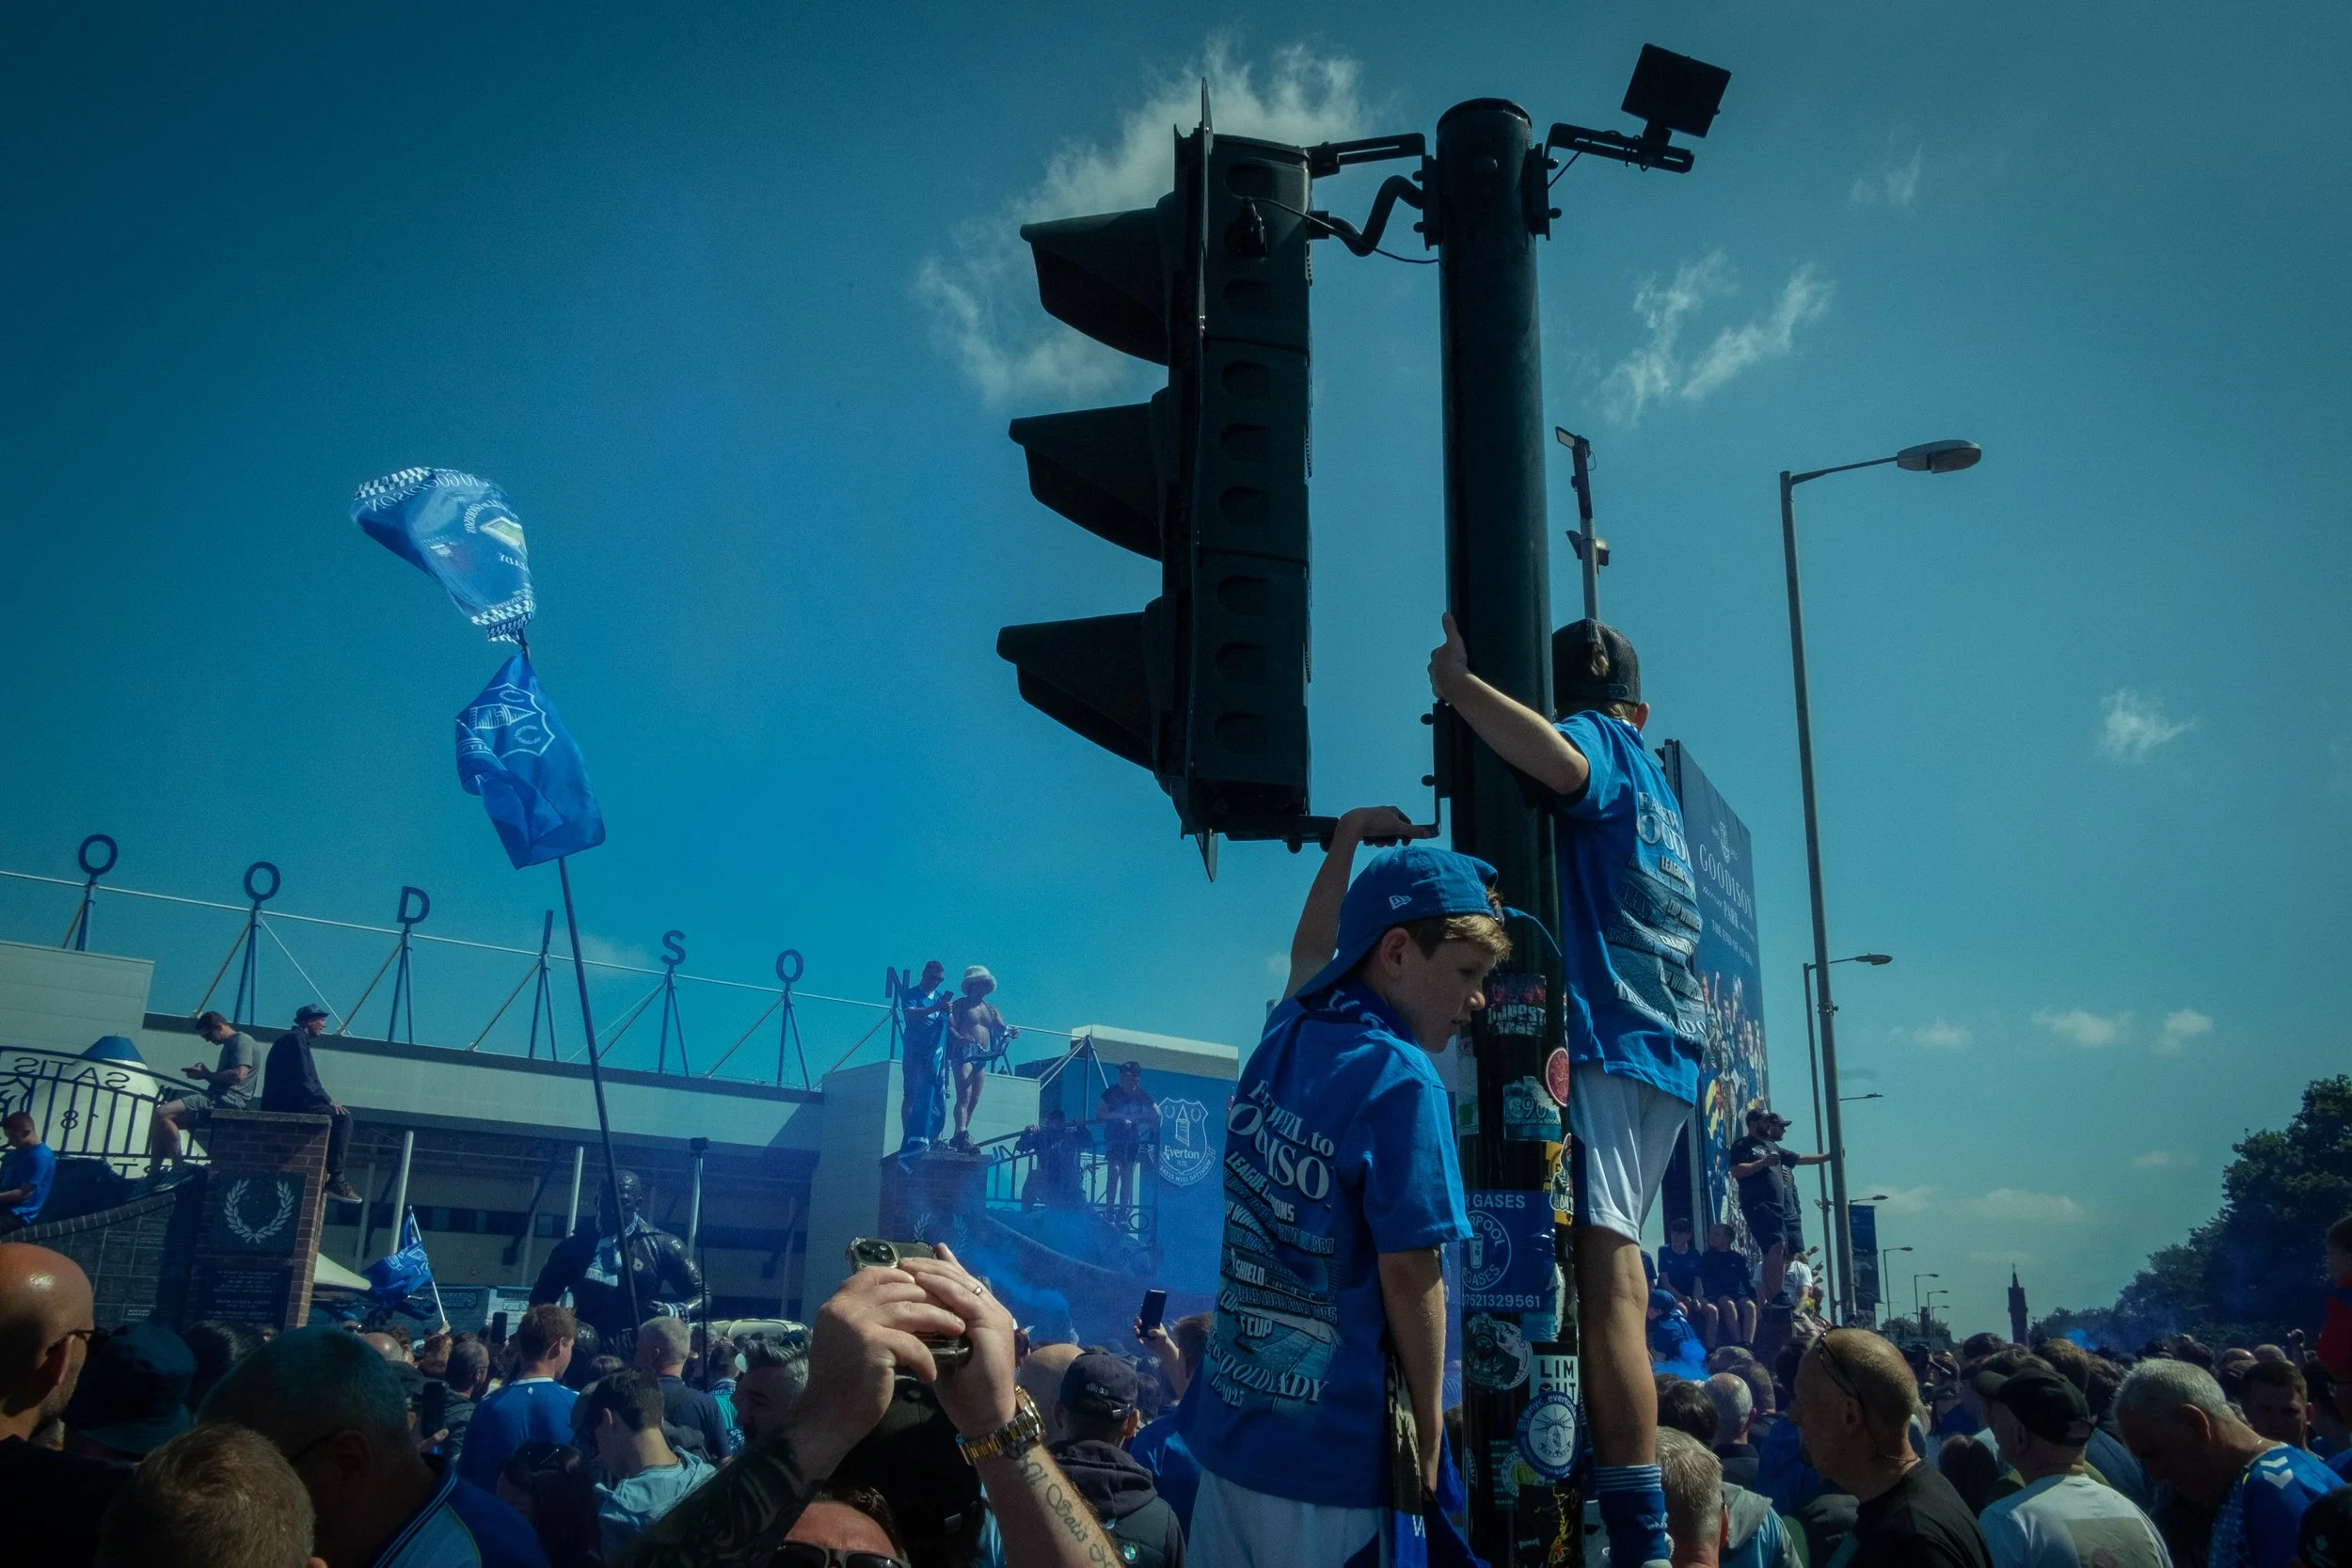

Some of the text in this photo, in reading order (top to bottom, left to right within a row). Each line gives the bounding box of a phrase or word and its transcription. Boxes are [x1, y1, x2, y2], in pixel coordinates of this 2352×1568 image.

[1699, 844, 1753, 922] GOODISON
[1164, 1145, 1200, 1160] Everton
[1311, 1131, 1335, 1157] to
[1225, 1150, 1268, 1194] LEAGUE
[1472, 1194, 1526, 1209] GASES
[1469, 1215, 1506, 1248] RPOOL
[1235, 1259, 1265, 1287] SHIELD
[1466, 1263, 1501, 1286] GASES
[1247, 1316, 1273, 1338] CUP
[1540, 1359, 1574, 1379] LIM
